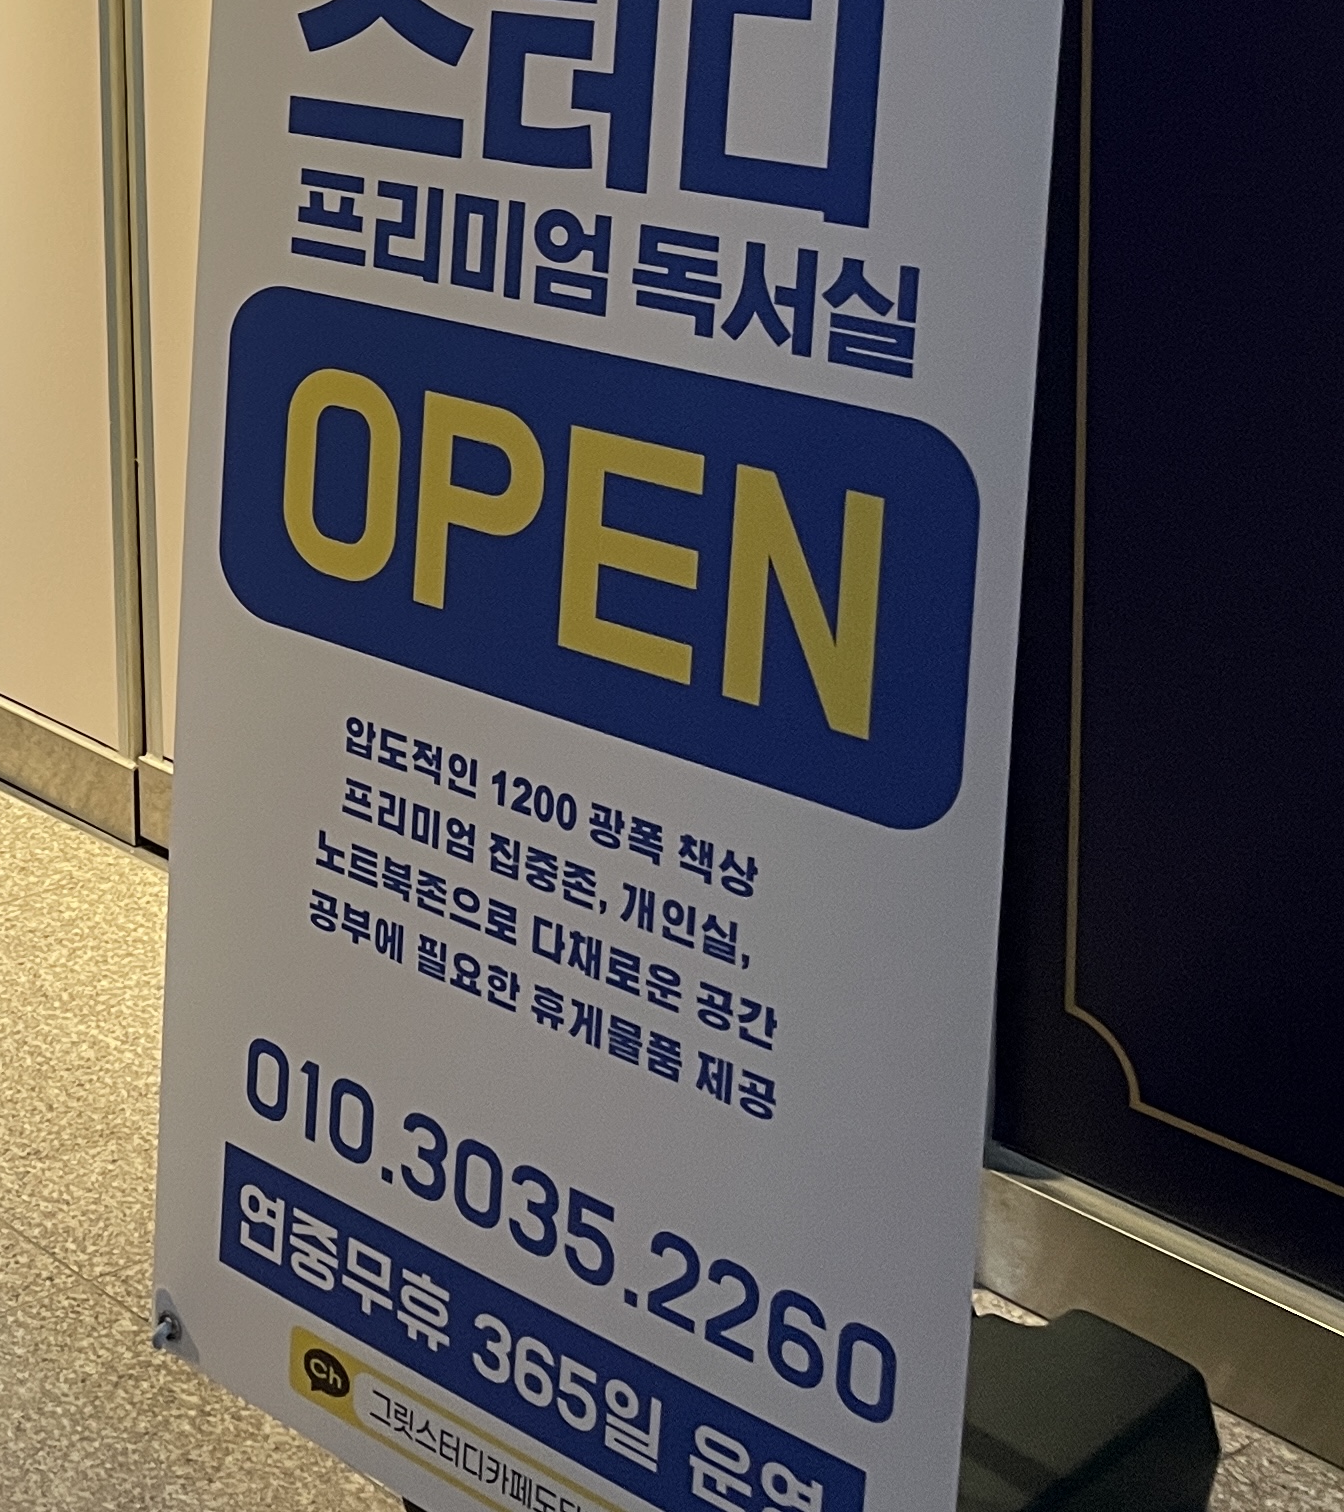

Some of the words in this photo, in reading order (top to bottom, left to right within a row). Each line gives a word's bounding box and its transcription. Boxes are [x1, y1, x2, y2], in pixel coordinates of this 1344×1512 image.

[289, 165, 614, 318] 프리미엄
[631, 220, 921, 379] 독서실
[282, 366, 887, 741] OPEN
[341, 777, 477, 864] 프리미엄
[489, 831, 608, 916] 집중존,
[619, 882, 751, 971] 개인실,
[345, 716, 478, 800] 압도적인
[490, 769, 578, 832] 1200
[588, 801, 664, 867] 광폭
[677, 833, 759, 899] 책상
[309, 888, 405, 965] 공부에
[417, 933, 521, 1013] 필요한
[530, 983, 683, 1084] 휴게물품
[695, 1049, 778, 1122] 제공
[315, 829, 518, 947] 노트북존으로
[531, 914, 683, 1014] 다채로운
[696, 980, 779, 1052] 공간
[238, 1181, 452, 1353] 연중무휴
[471, 1312, 663, 1475] 365일
[245, 1036, 898, 1425] 010.3035.2260
